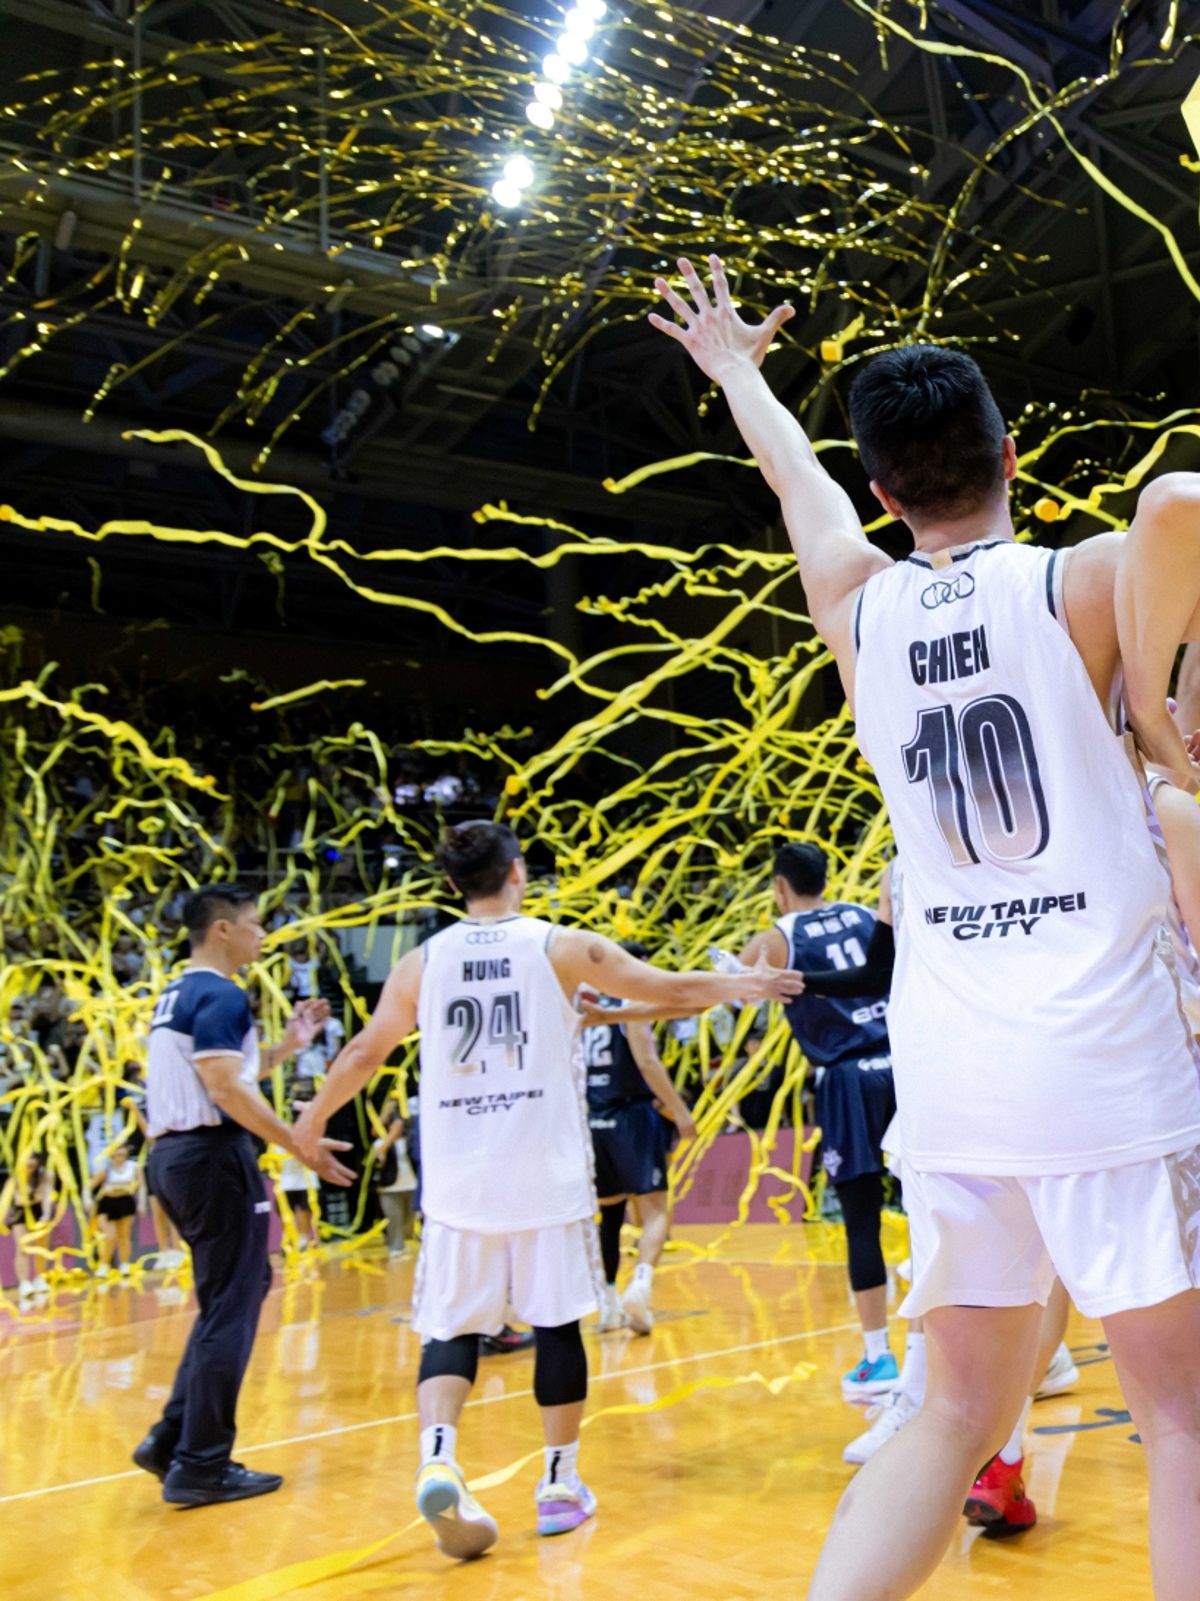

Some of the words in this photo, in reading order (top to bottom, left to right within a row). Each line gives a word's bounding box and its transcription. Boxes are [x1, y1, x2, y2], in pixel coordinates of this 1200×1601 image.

[908, 624, 990, 686] CHIEN
[901, 694, 1050, 867] 10
[925, 905, 986, 924] NEW
[991, 892, 1086, 920] TAIPEI
[952, 917, 1042, 940] CITY
[826, 936, 867, 970] 11
[463, 958, 511, 982] HUNG
[445, 991, 528, 1076] 24
[439, 1094, 484, 1109] NEW
[487, 1089, 543, 1104] TAIPEI
[467, 1103, 515, 1116] CITY
